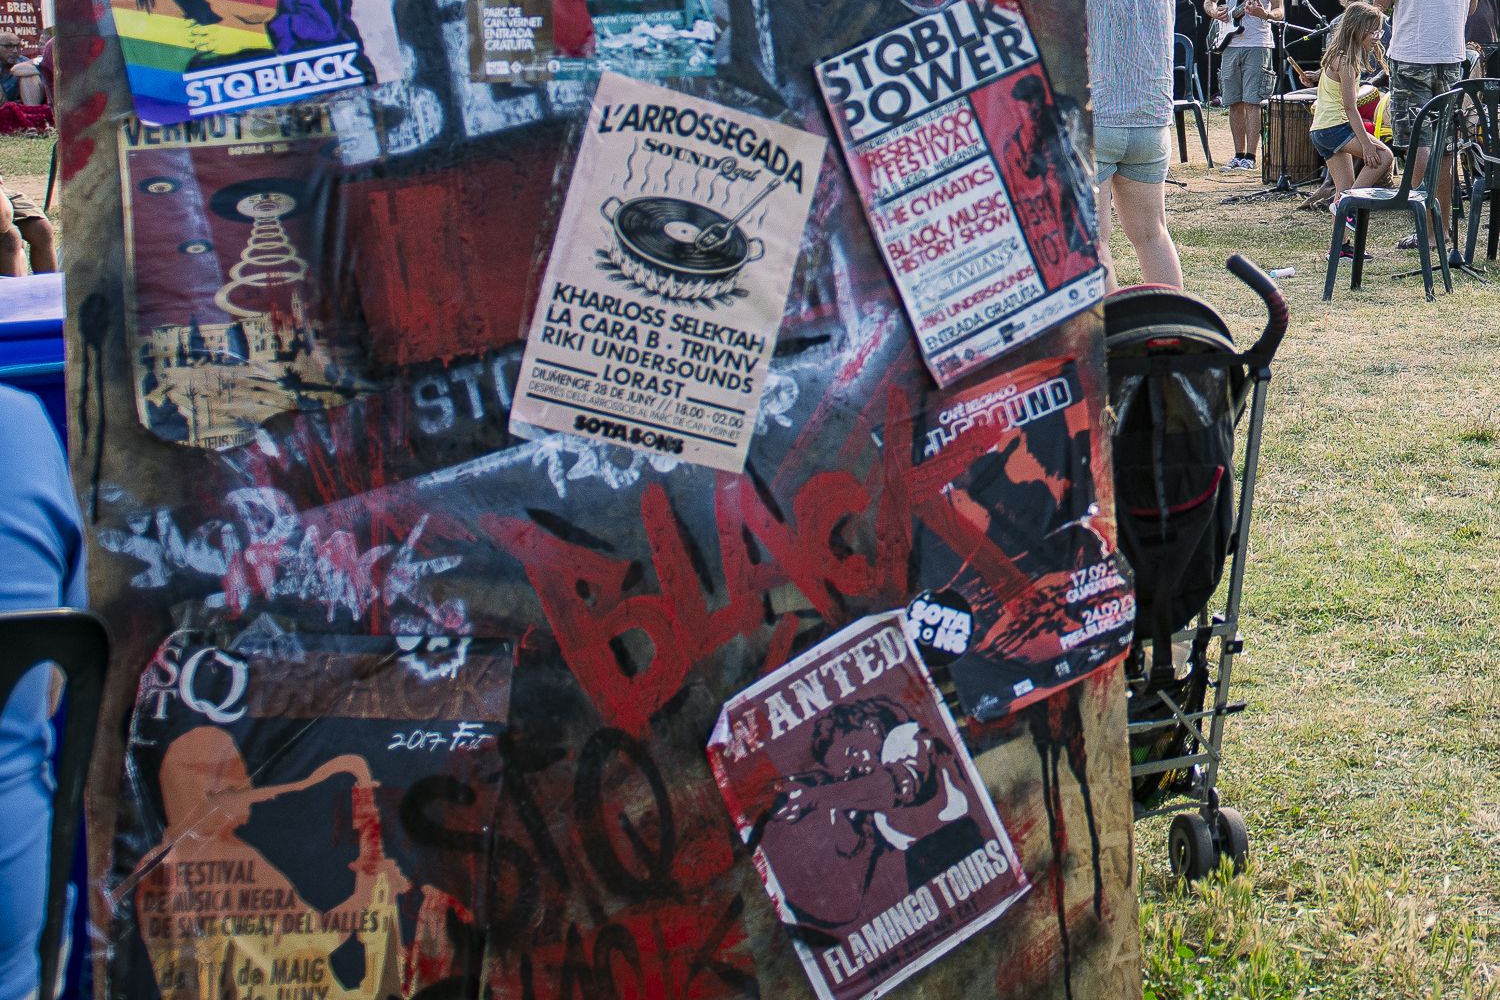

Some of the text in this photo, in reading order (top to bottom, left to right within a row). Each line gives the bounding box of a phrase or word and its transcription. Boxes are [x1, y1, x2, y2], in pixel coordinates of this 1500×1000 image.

[7, 2, 35, 14] BREN
[16, 15, 37, 25] KALI
[483, 7, 521, 18] PARC DE
[14, 27, 37, 37] WINE
[483, 28, 534, 40] ENTRADA
[838, 26, 1039, 128] POWER
[598, 103, 803, 194] L'ARROSSEGADA
[642, 136, 718, 171] SOUND
[885, 127, 980, 182] FESTIVAL
[910, 164, 995, 216] CYMATICS
[886, 190, 1008, 261] BLACK MUSIC
[897, 236, 958, 274] HISTORY
[959, 207, 1011, 245] SHOW
[949, 264, 1035, 317] UNDERSOUNDS
[552, 282, 765, 355] KHARLOSS SELEKTAH
[925, 312, 983, 349] ENTRADA
[546, 304, 760, 375] LA CARA B TRIVNV
[541, 325, 754, 395] RIKI UNDERSOUNDS
[531, 366, 591, 392] DIUMENGE
[593, 381, 608, 396] 28
[610, 384, 625, 399] DE
[627, 389, 656, 407] JUNY
[602, 363, 686, 399] LORAST
[911, 600, 972, 636] SOTA
[724, 625, 909, 764] WANTED
[176, 859, 256, 886] FESTIVAL
[236, 888, 297, 912] NEGRA
[821, 839, 1010, 986] FLAMINGO TOURS
[148, 906, 380, 939] DE SANT CUGAT DEL VALLÈS
[236, 958, 325, 987] de MAIG
